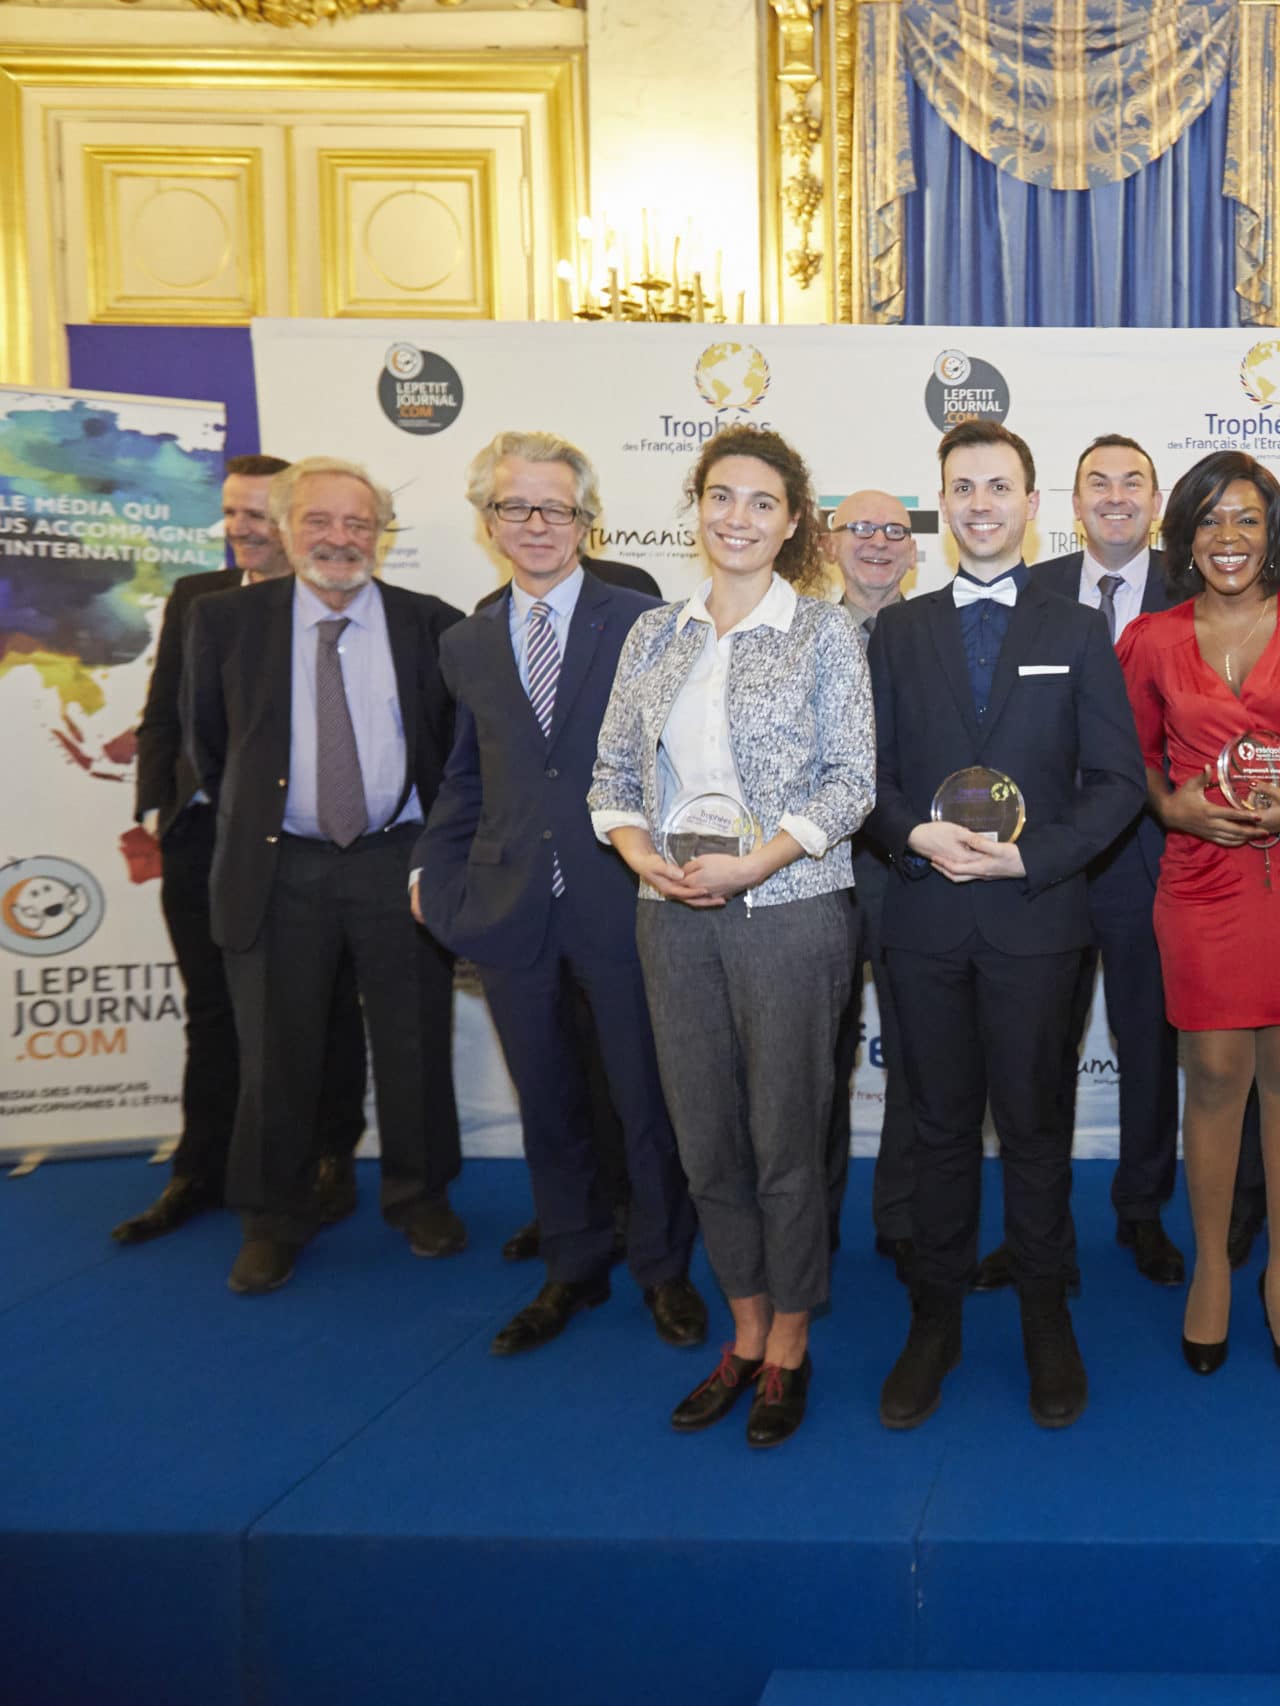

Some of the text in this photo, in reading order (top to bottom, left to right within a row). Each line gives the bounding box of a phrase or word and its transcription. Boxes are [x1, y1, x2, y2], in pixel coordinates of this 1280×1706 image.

[396, 382, 448, 395] LEPETIT
[943, 388, 996, 400] LEPETIT
[396, 394, 457, 408] JOURNAL
[943, 400, 1004, 414] JOURNAL
[640, 439, 693, 454] Français
[1167, 441, 1183, 449] des
[1185, 437, 1238, 452] Français
[1240, 440, 1251, 450] de
[0, 494, 170, 522] LE MÉDIA QUI
[32, 518, 209, 544] ACCOMPAGNE
[15, 962, 178, 997] LEPETIT
[13, 994, 182, 1037] JOURNA
[15, 1026, 128, 1061] .COM
